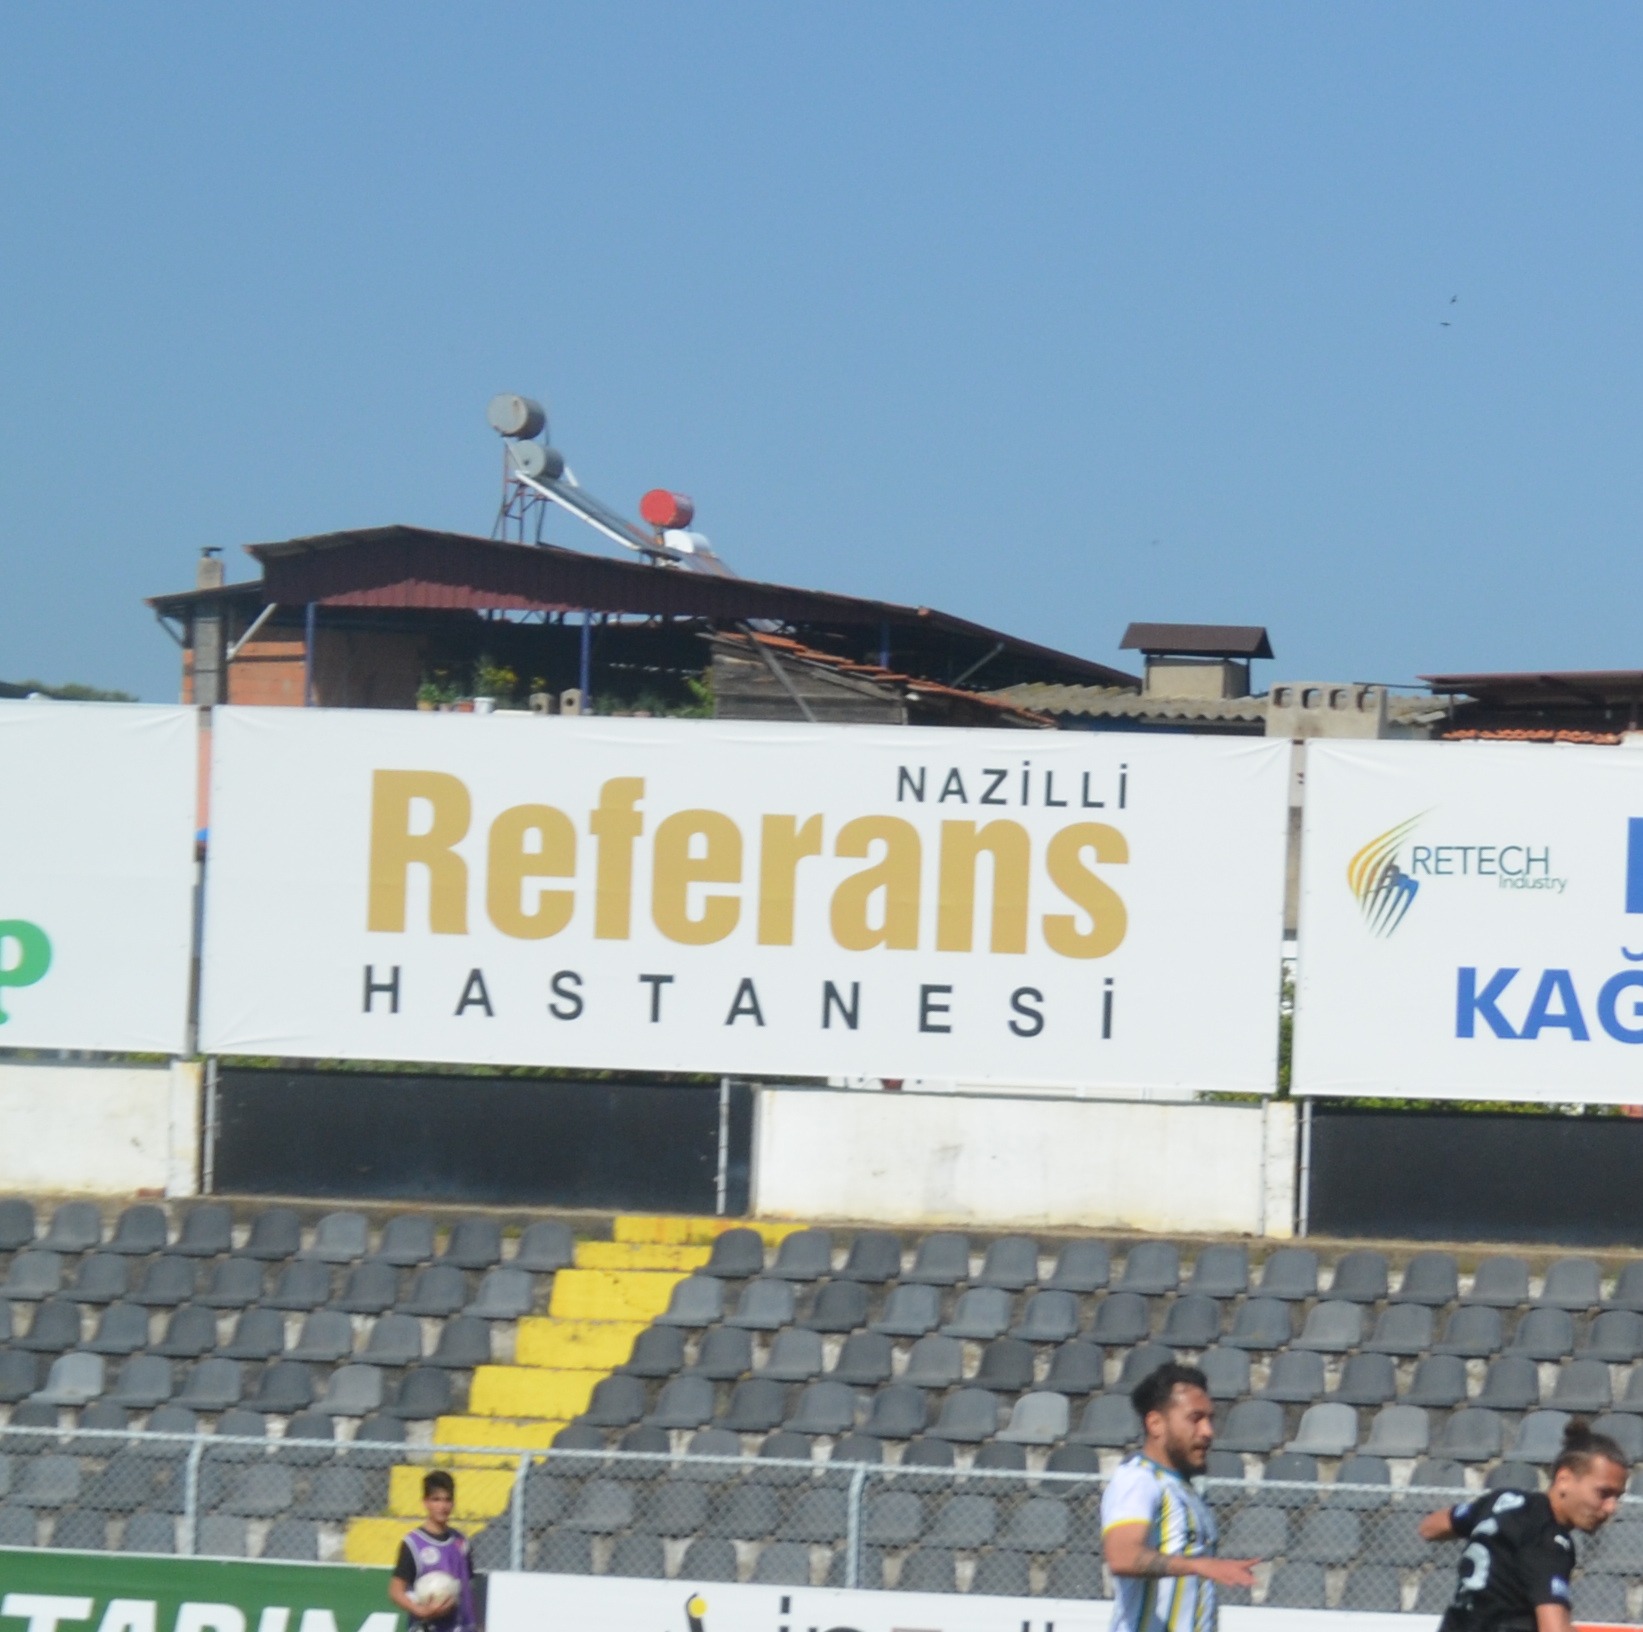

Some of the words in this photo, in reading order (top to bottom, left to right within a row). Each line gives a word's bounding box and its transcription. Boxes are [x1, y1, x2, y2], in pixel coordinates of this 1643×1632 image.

[897, 759, 1129, 810] NAZİLLİ
[367, 769, 1130, 959] Referans
[1411, 845, 1550, 876] RETECH
[1499, 873, 1568, 894] Industry
[362, 963, 1115, 1040] HASTANESİ
